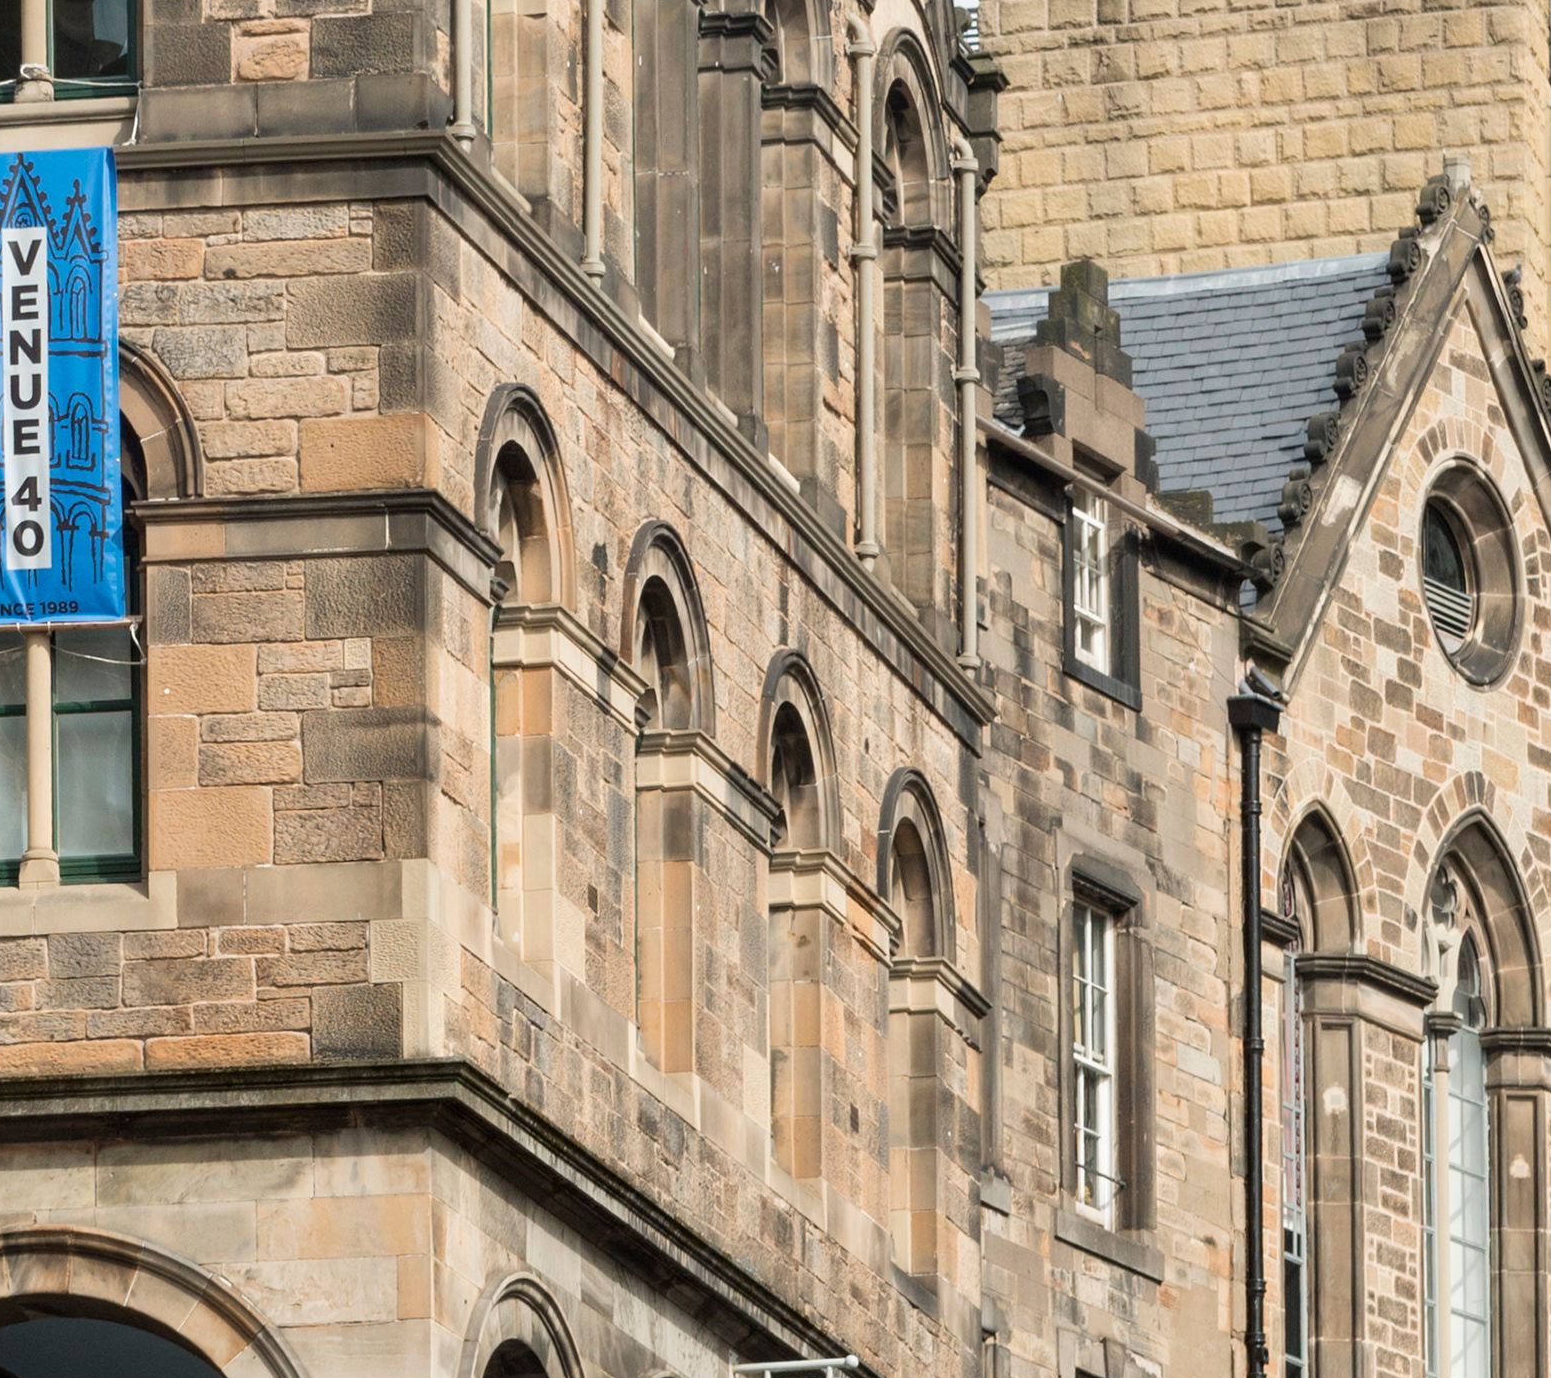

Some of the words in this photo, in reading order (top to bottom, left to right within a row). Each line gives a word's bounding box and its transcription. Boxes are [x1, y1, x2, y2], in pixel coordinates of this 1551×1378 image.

[7, 238, 42, 455] VENUE
[11, 476, 44, 556] 40
[40, 601, 79, 615] 1989
